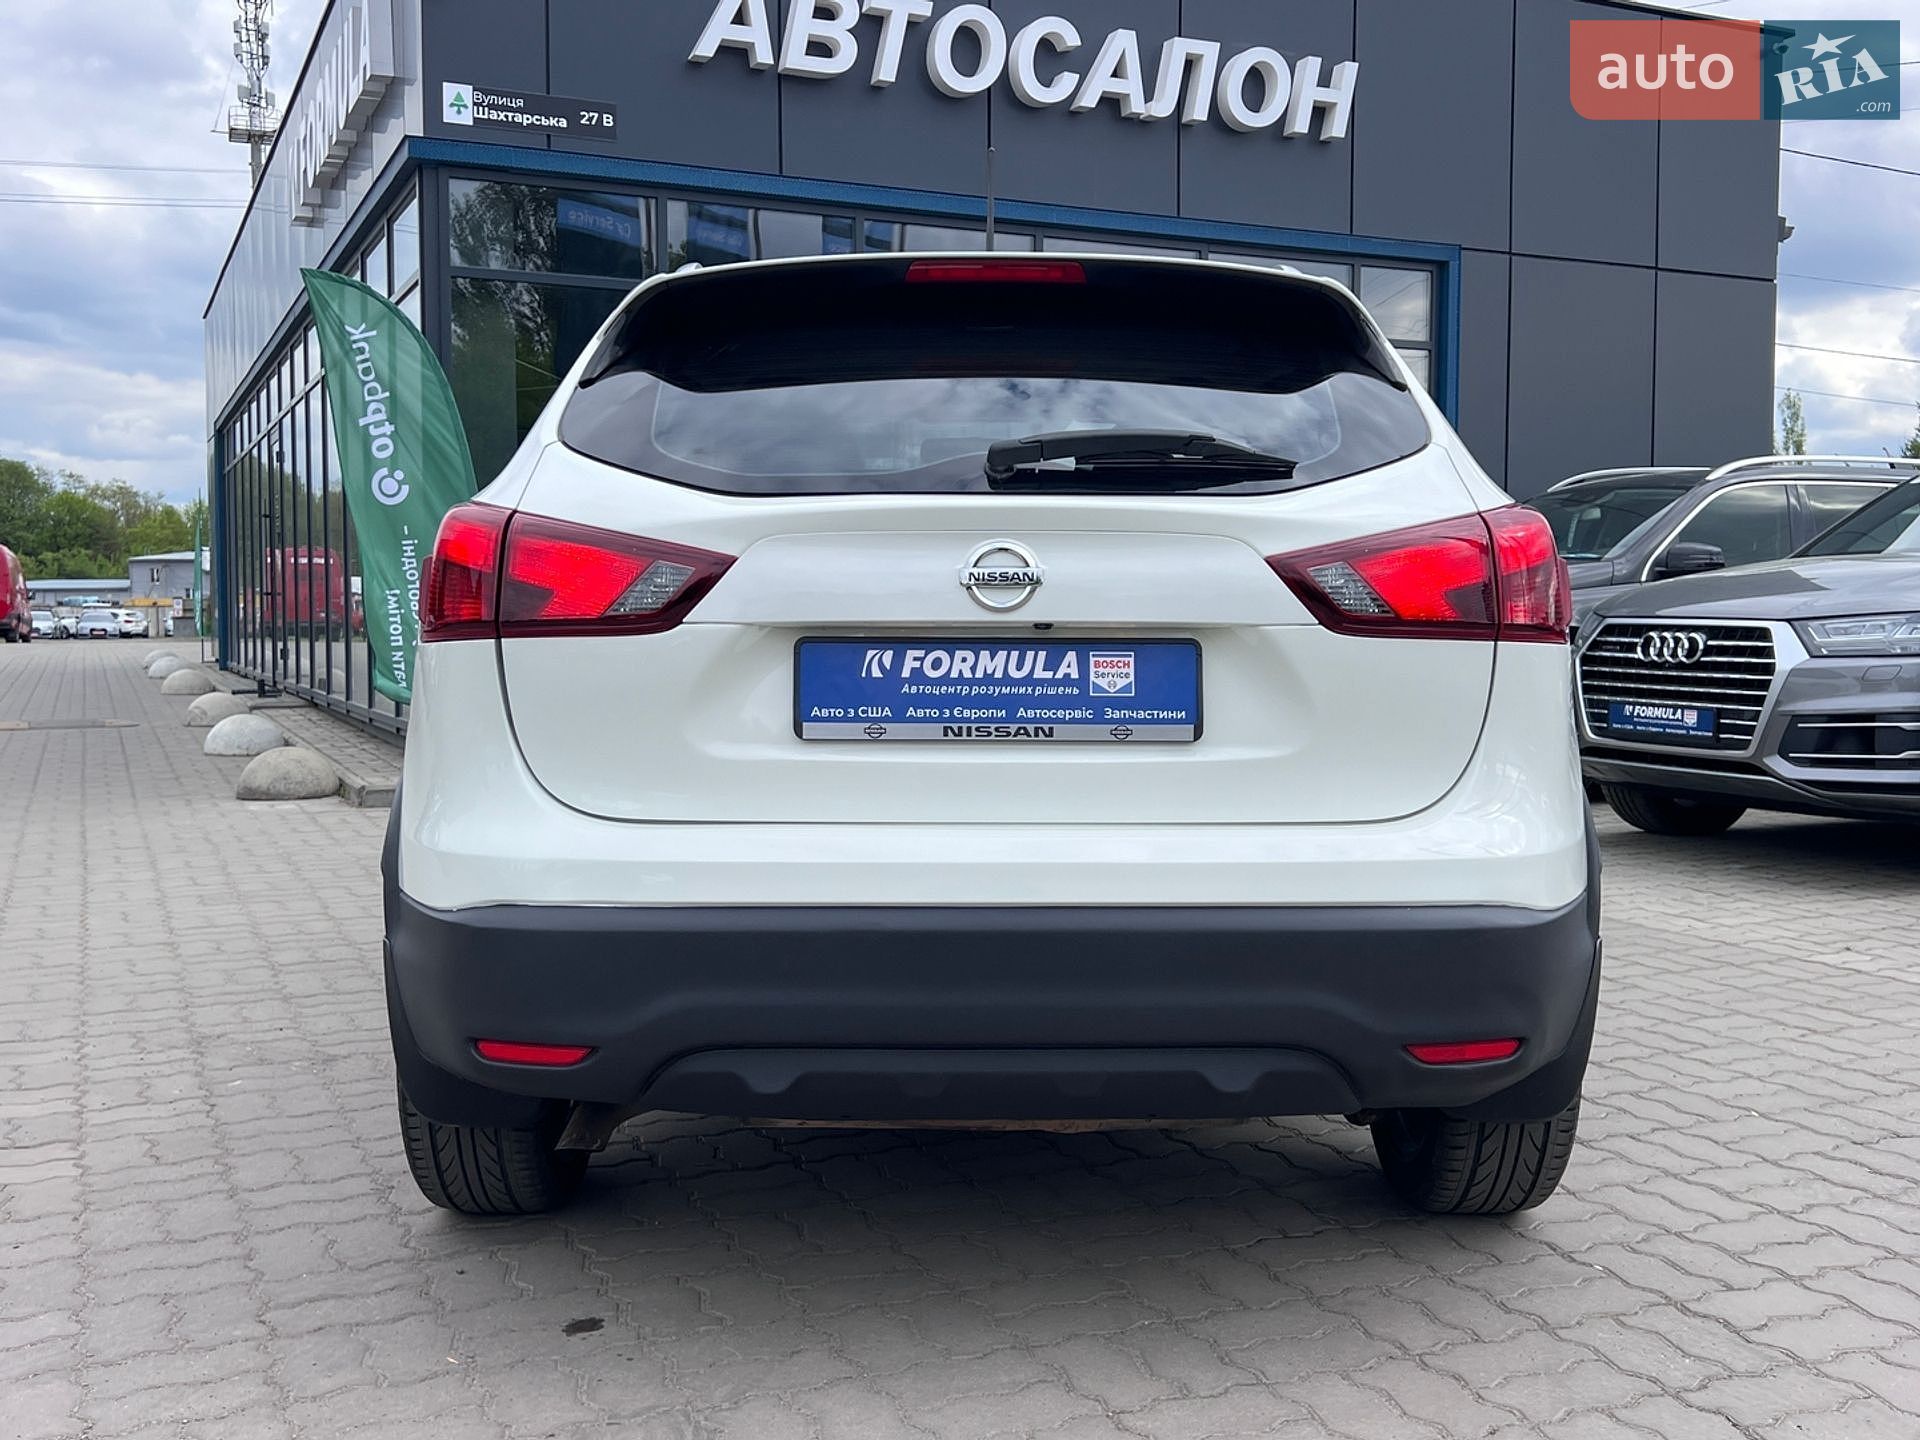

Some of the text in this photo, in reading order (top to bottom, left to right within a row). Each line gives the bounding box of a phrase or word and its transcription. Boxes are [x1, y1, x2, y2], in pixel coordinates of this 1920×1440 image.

[688, 0, 1359, 141] АВТОСАЛОН
[299, 0, 383, 207] FORMULA
[473, 90, 524, 109] Вулиця
[473, 105, 568, 128] Шахтарська
[579, 111, 598, 125] 27
[968, 571, 1035, 583] NISSAN
[901, 649, 1079, 679] FORMULA
[1093, 660, 1131, 669] BOSCH
[1093, 670, 1131, 679] Service
[901, 682, 1080, 697] Автоцентр розумних рішень
[810, 706, 1186, 720] Авто з США Авто з Європи Автосервіс Запчастини
[1633, 705, 1683, 720] FORMULA
[943, 725, 1054, 738] NISSAN
